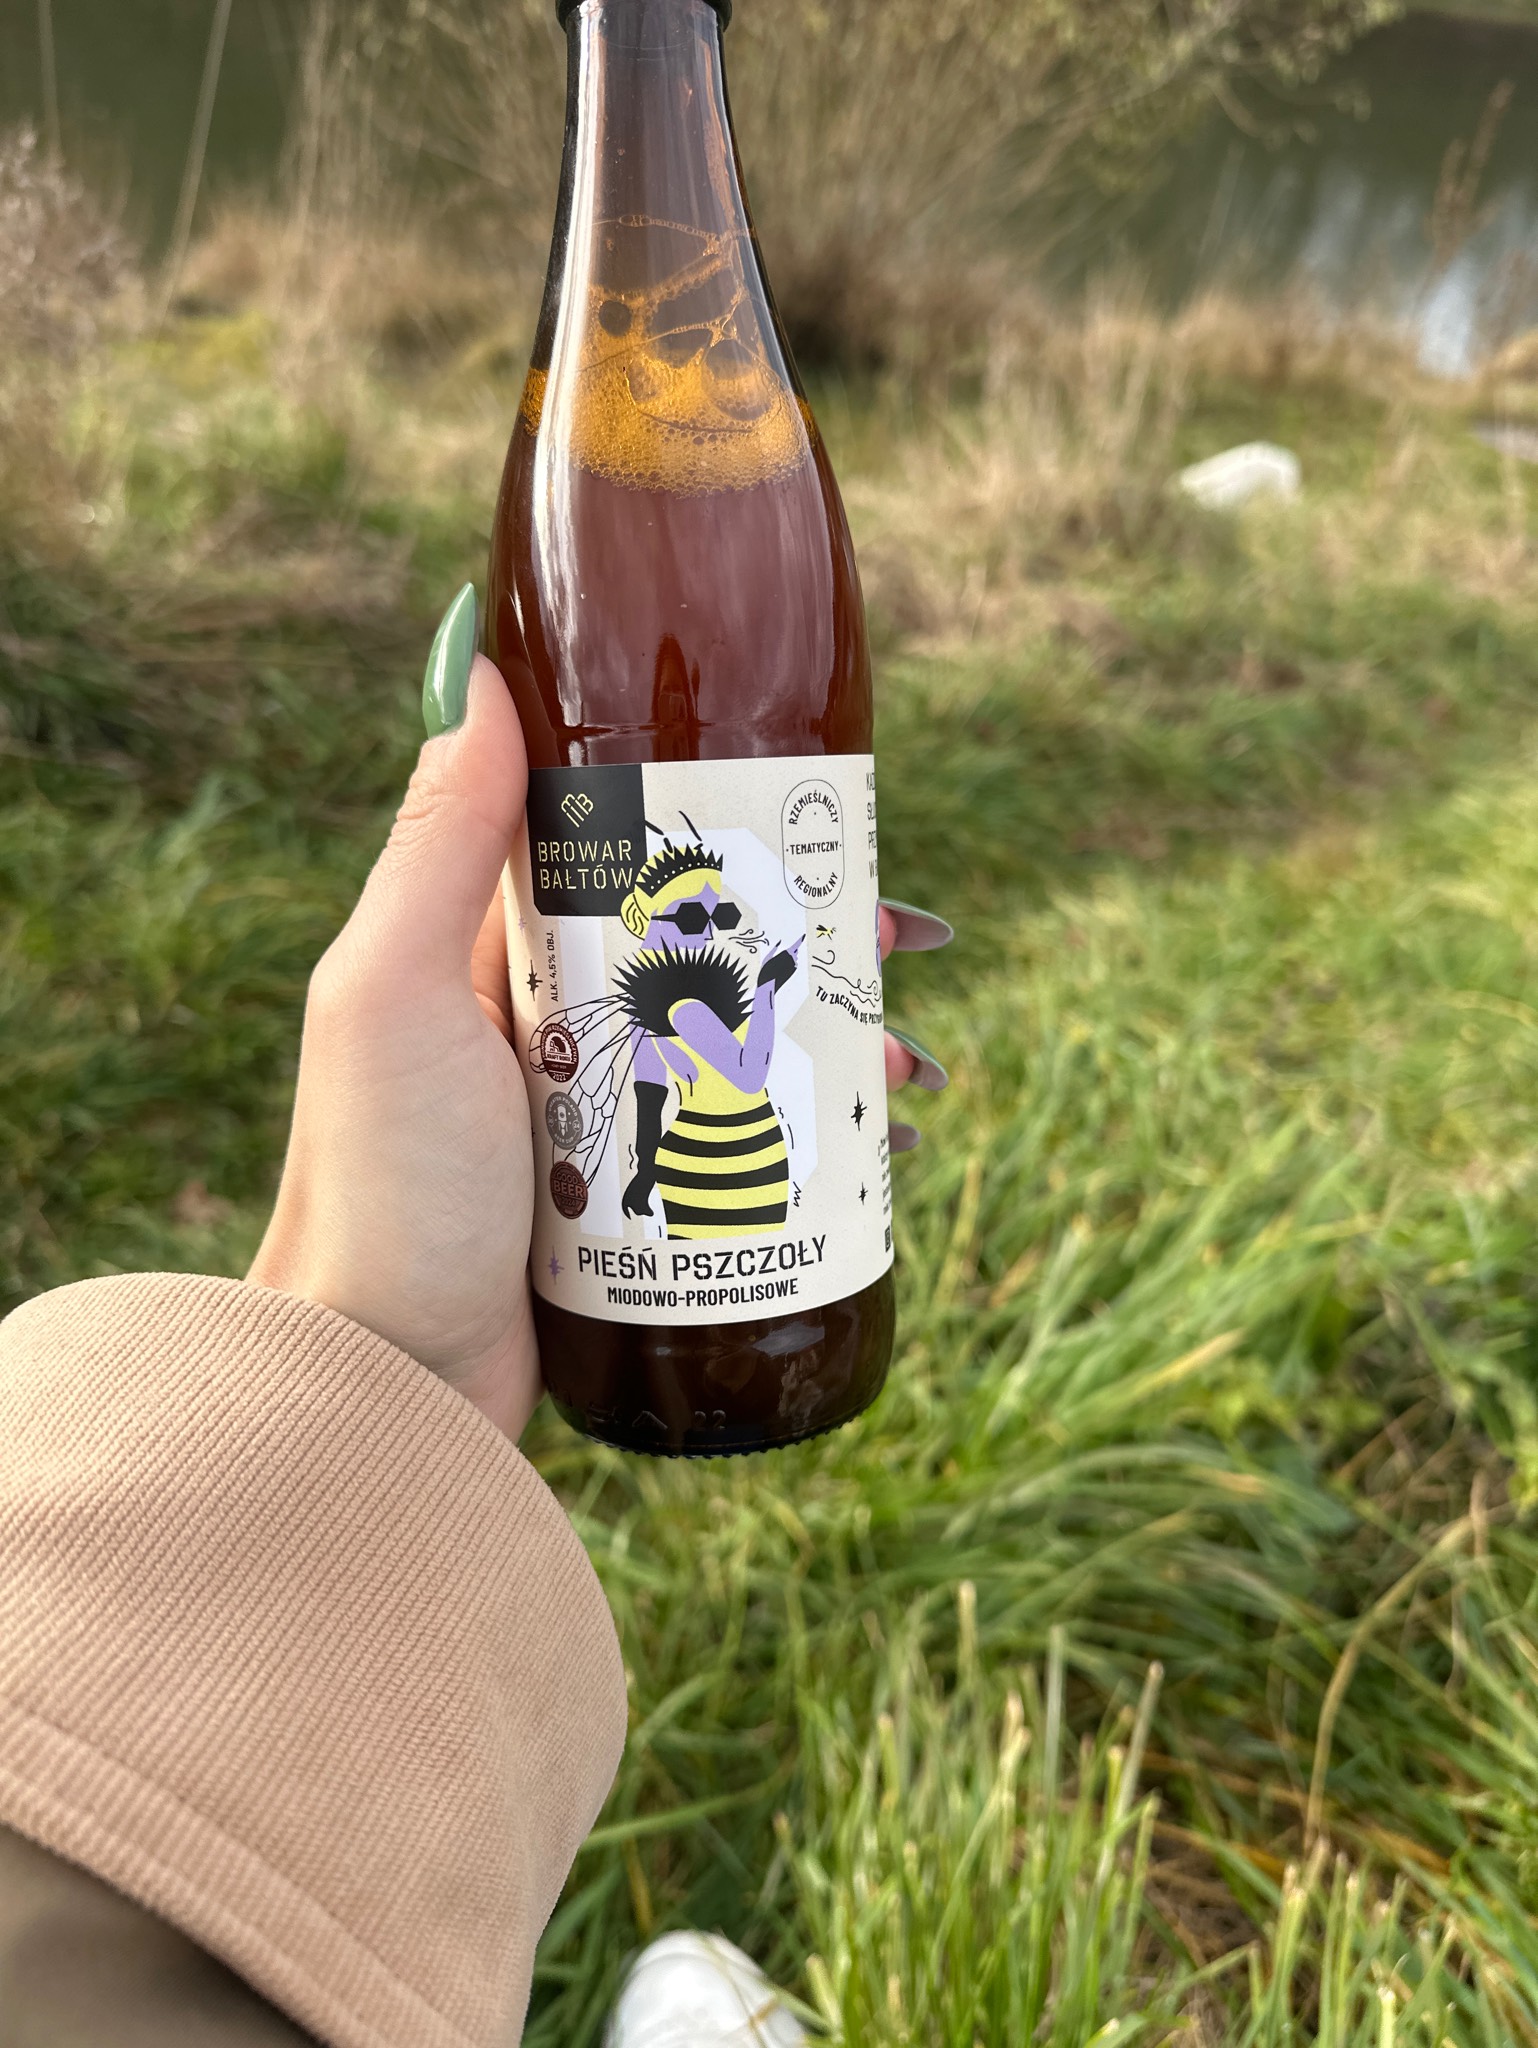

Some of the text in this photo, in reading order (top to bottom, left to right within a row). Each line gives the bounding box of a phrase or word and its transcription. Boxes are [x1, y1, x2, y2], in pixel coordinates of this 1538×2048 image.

[788, 789, 839, 825] RZEMIEŚLNICZY
[537, 839, 632, 862] BROWAR
[790, 840, 839, 855] TEMATYCZNY
[540, 864, 633, 890] BAŁTÓW
[793, 871, 839, 898] REGIONALNY
[546, 930, 559, 1002] ALK. 4,5% OBJ.
[815, 985, 828, 1002] TU
[829, 993, 859, 1020] ZACZYNA
[553, 1180, 584, 1199] BEER
[556, 1172, 579, 1185] GOOD
[578, 1234, 827, 1281] PIEŚŃ PSZCZOŁY
[607, 1277, 799, 1308] MIODOWO-PROPOLISOWE
